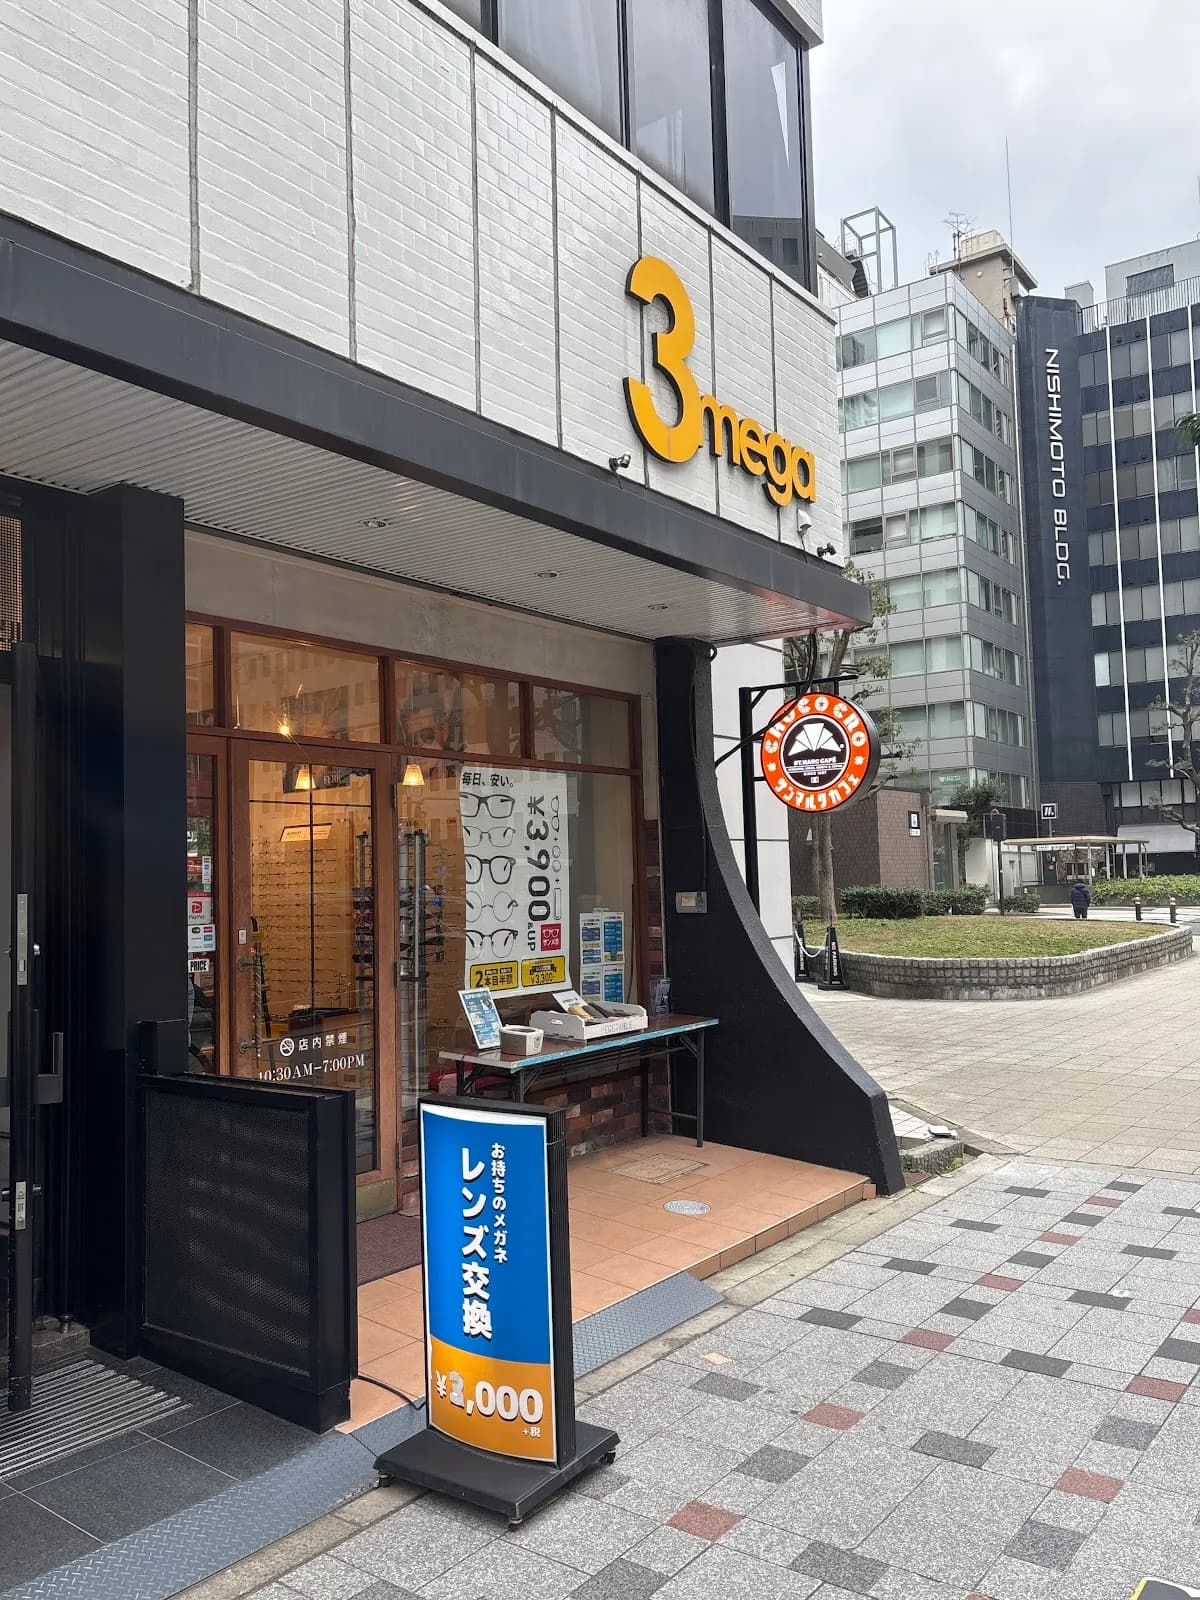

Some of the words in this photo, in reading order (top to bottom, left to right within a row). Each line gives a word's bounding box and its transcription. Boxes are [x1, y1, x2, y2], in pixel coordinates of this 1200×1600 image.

[1045, 348, 1067, 499] NISHIMOTO
[1053, 508, 1071, 586] BLDG.
[462, 771, 514, 788] 毎日、安い。
[775, 774, 860, 809] サンマルクカフェ
[524, 795, 551, 922] ¥3,900
[190, 960, 207, 972] PRICE
[298, 1032, 348, 1051] 店内禁煙
[491, 1142, 508, 1264] お持ちのメガネ
[461, 1147, 493, 1340] レンズ交換
